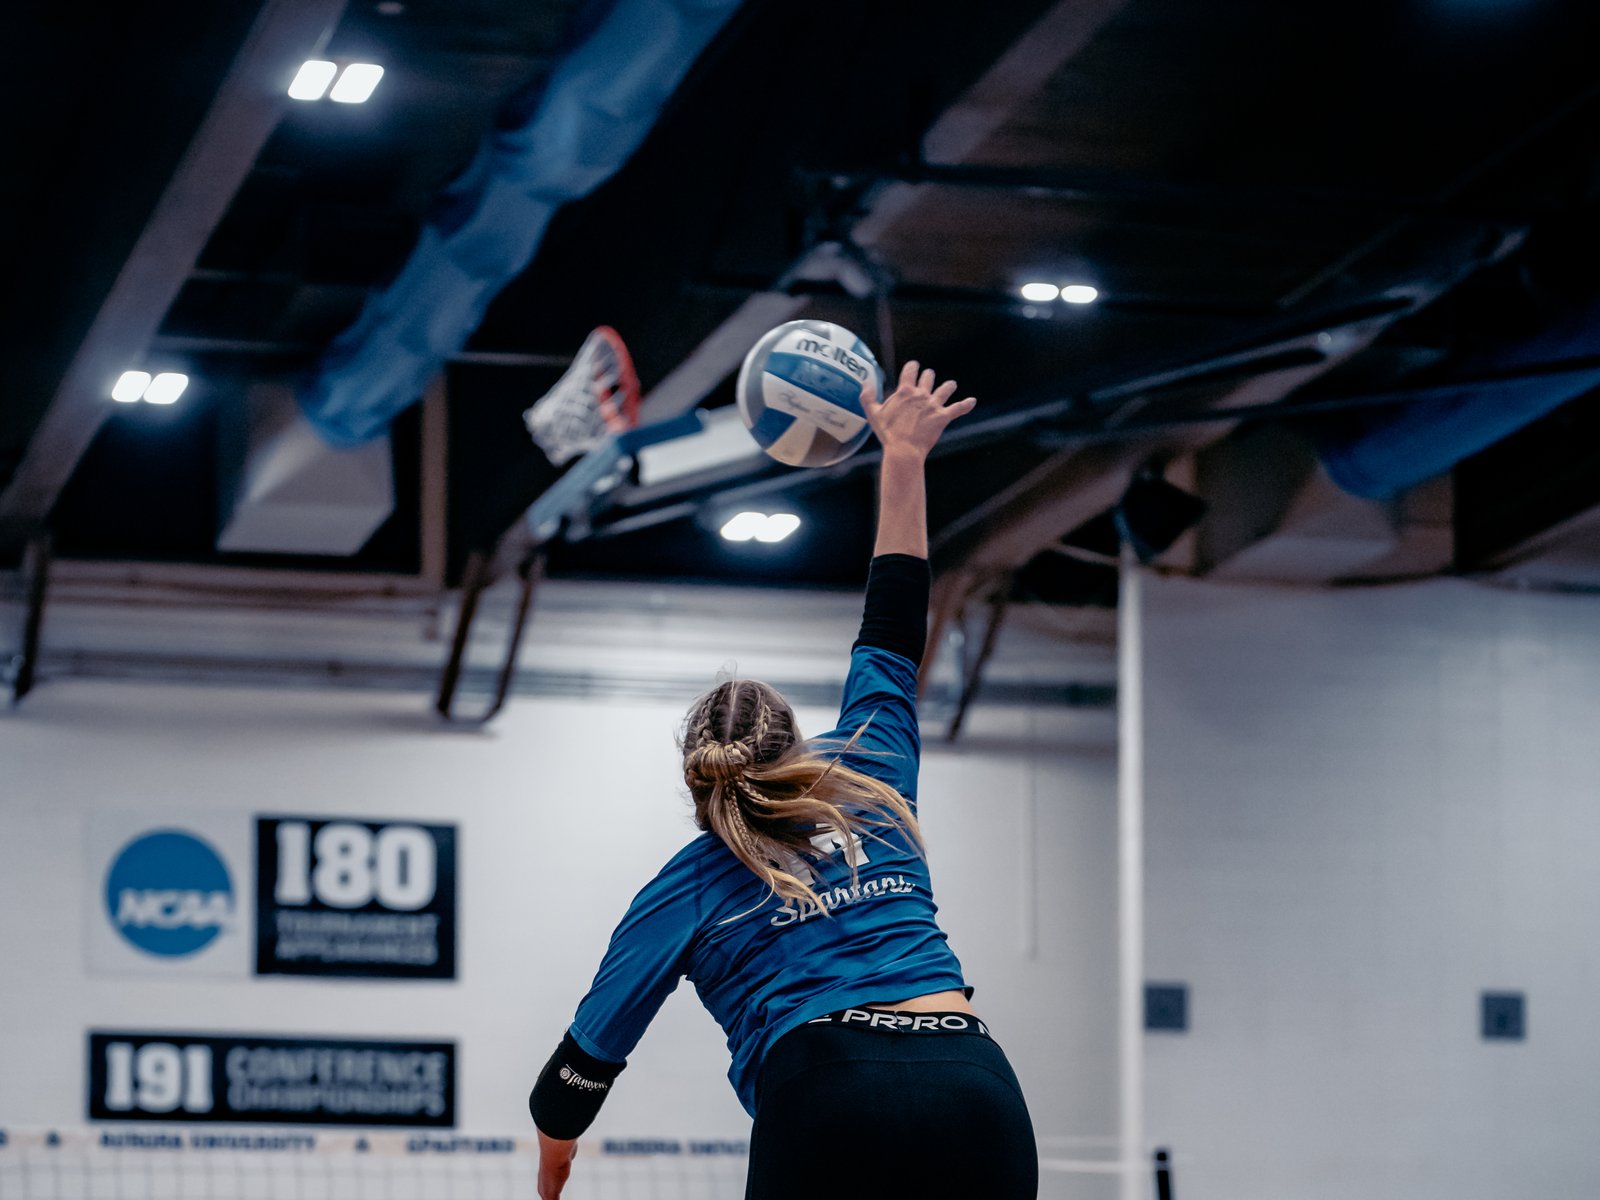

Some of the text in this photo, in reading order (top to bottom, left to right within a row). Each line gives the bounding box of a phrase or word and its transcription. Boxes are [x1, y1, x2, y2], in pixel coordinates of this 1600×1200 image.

[275, 821, 437, 911] 180
[117, 888, 239, 929] NCAA
[105, 1041, 213, 1113] 191
